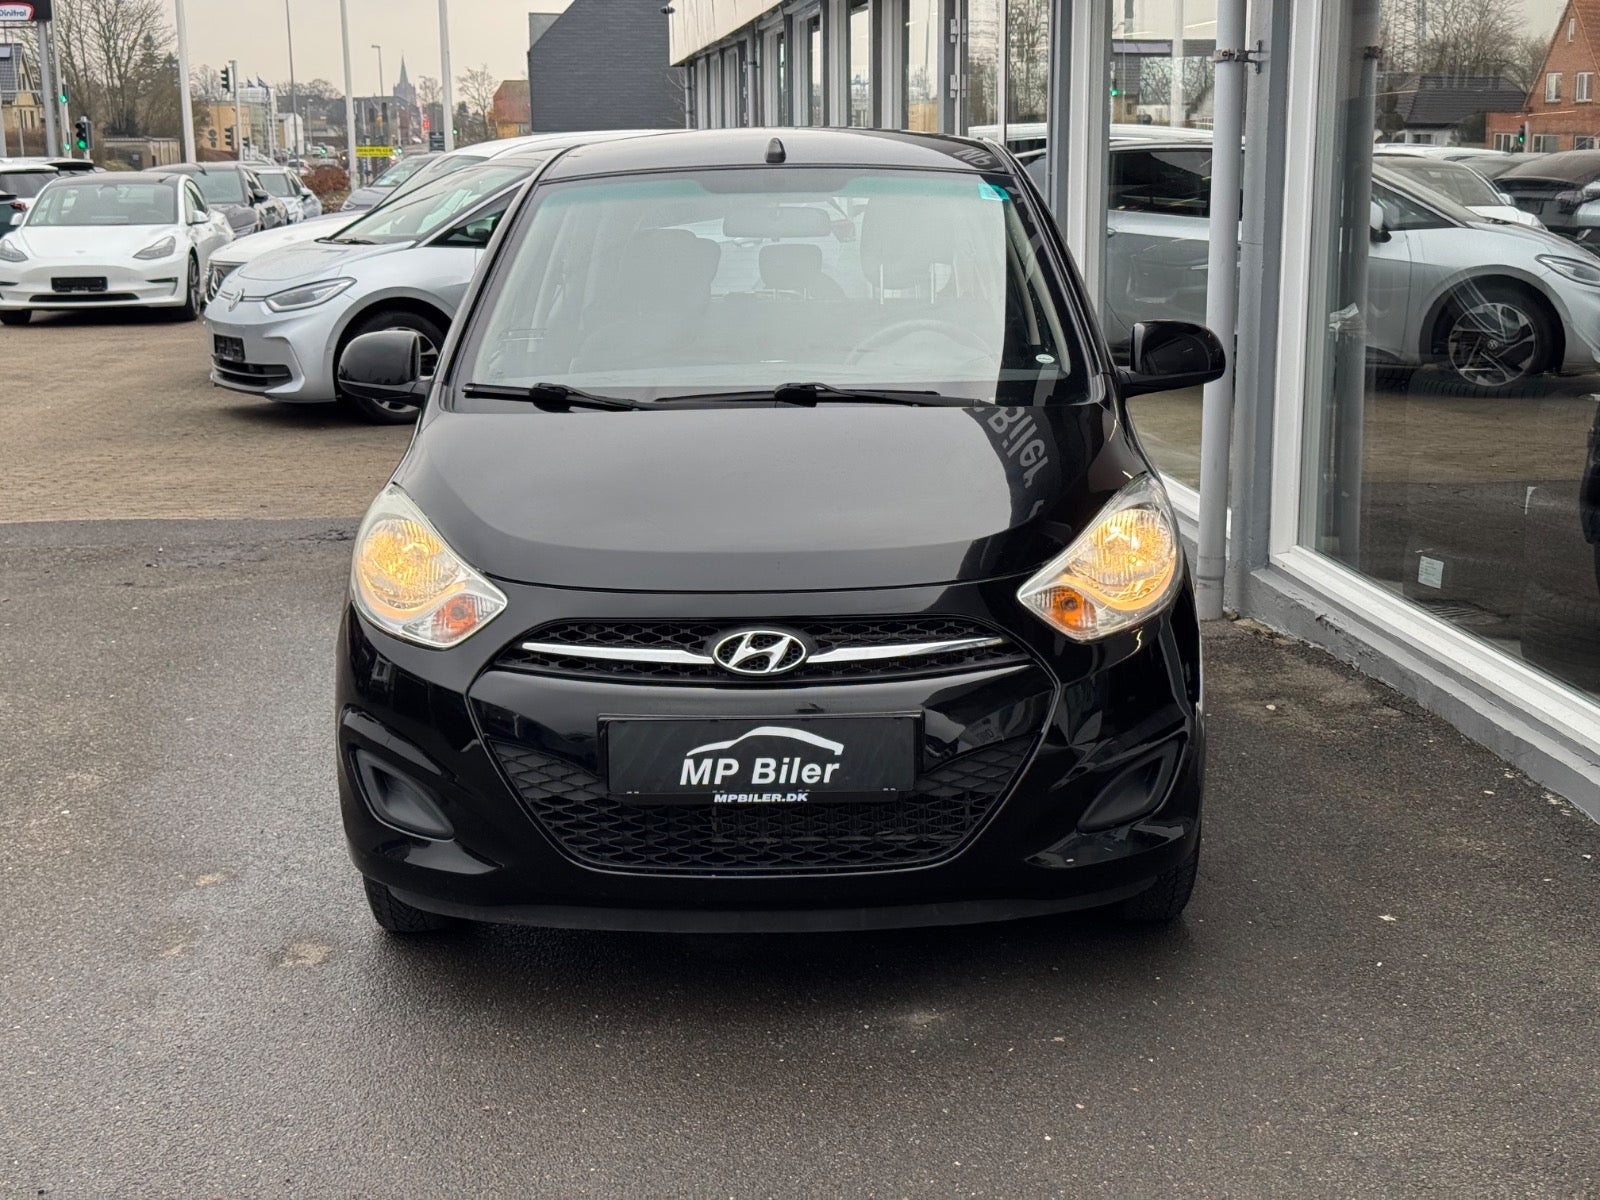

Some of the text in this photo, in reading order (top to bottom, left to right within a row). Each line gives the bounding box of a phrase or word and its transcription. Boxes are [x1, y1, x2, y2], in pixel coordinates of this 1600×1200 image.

[680, 757, 839, 785] MP Biler
[714, 793, 808, 802] MPBILER.DK
